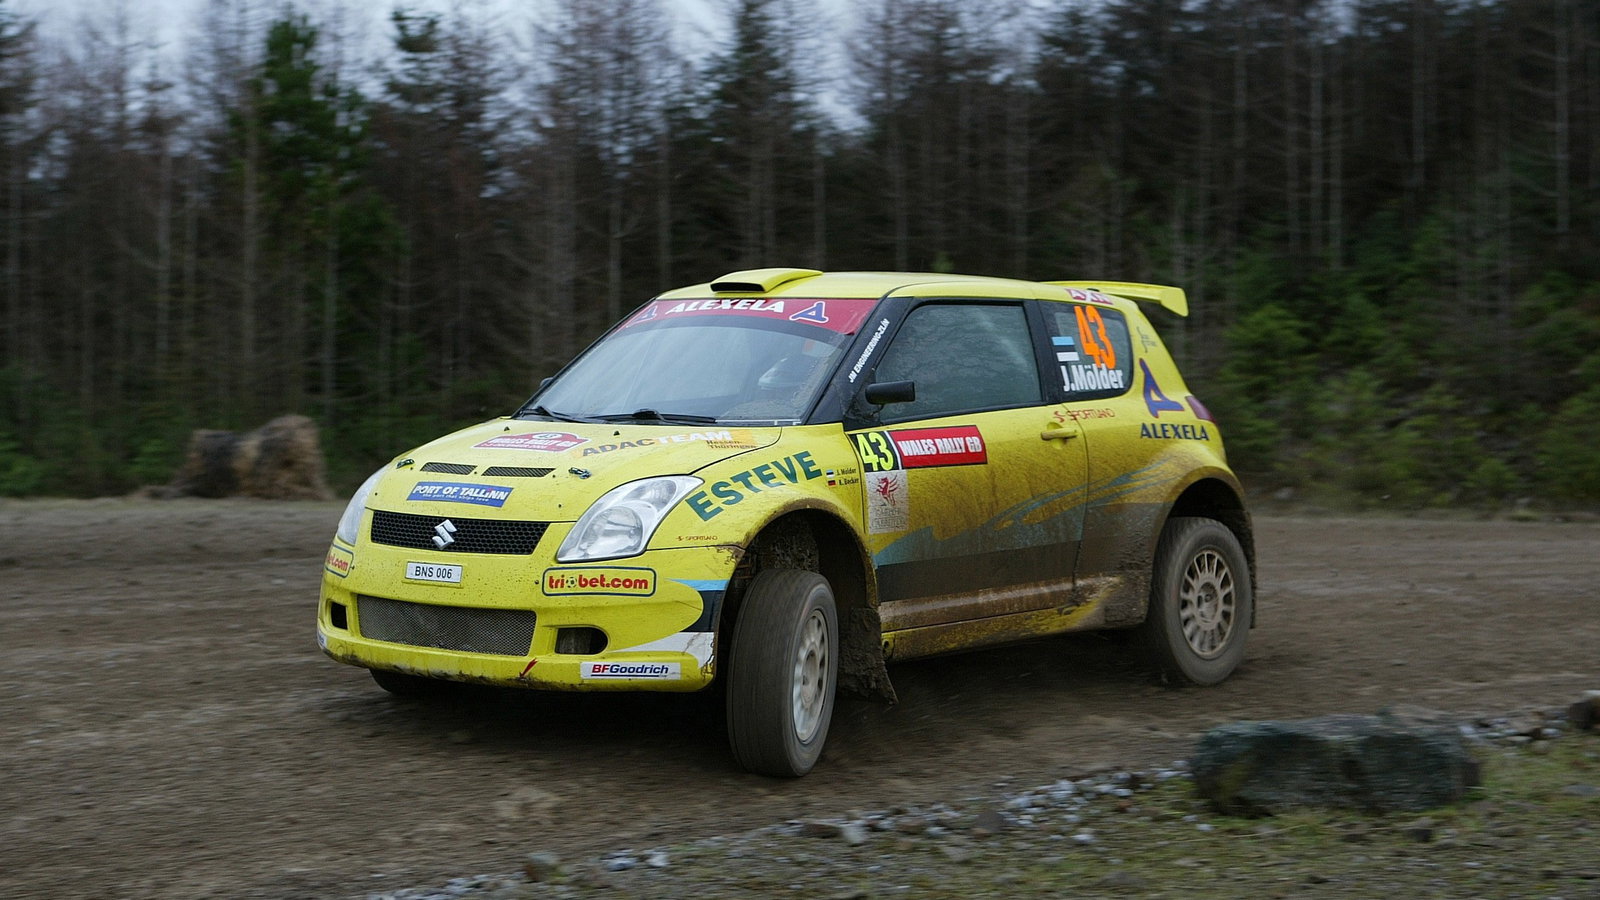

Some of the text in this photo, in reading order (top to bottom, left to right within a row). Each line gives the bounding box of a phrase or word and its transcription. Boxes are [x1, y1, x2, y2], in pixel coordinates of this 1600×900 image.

[665, 299, 785, 315] ALEXELA
[1074, 305, 1116, 369] 43
[848, 370, 857, 383] JM
[1060, 363, 1124, 392] J.Mölder
[1140, 422, 1210, 441] ALEXELA
[857, 432, 894, 471] 43
[897, 436, 982, 456] WALES RALLY GB
[412, 485, 442, 494] PORT
[442, 486, 460, 495] OF
[685, 451, 823, 522] ESTEVE
[415, 566, 453, 579] BNS 006
[591, 664, 670, 675] BFGoodrich
